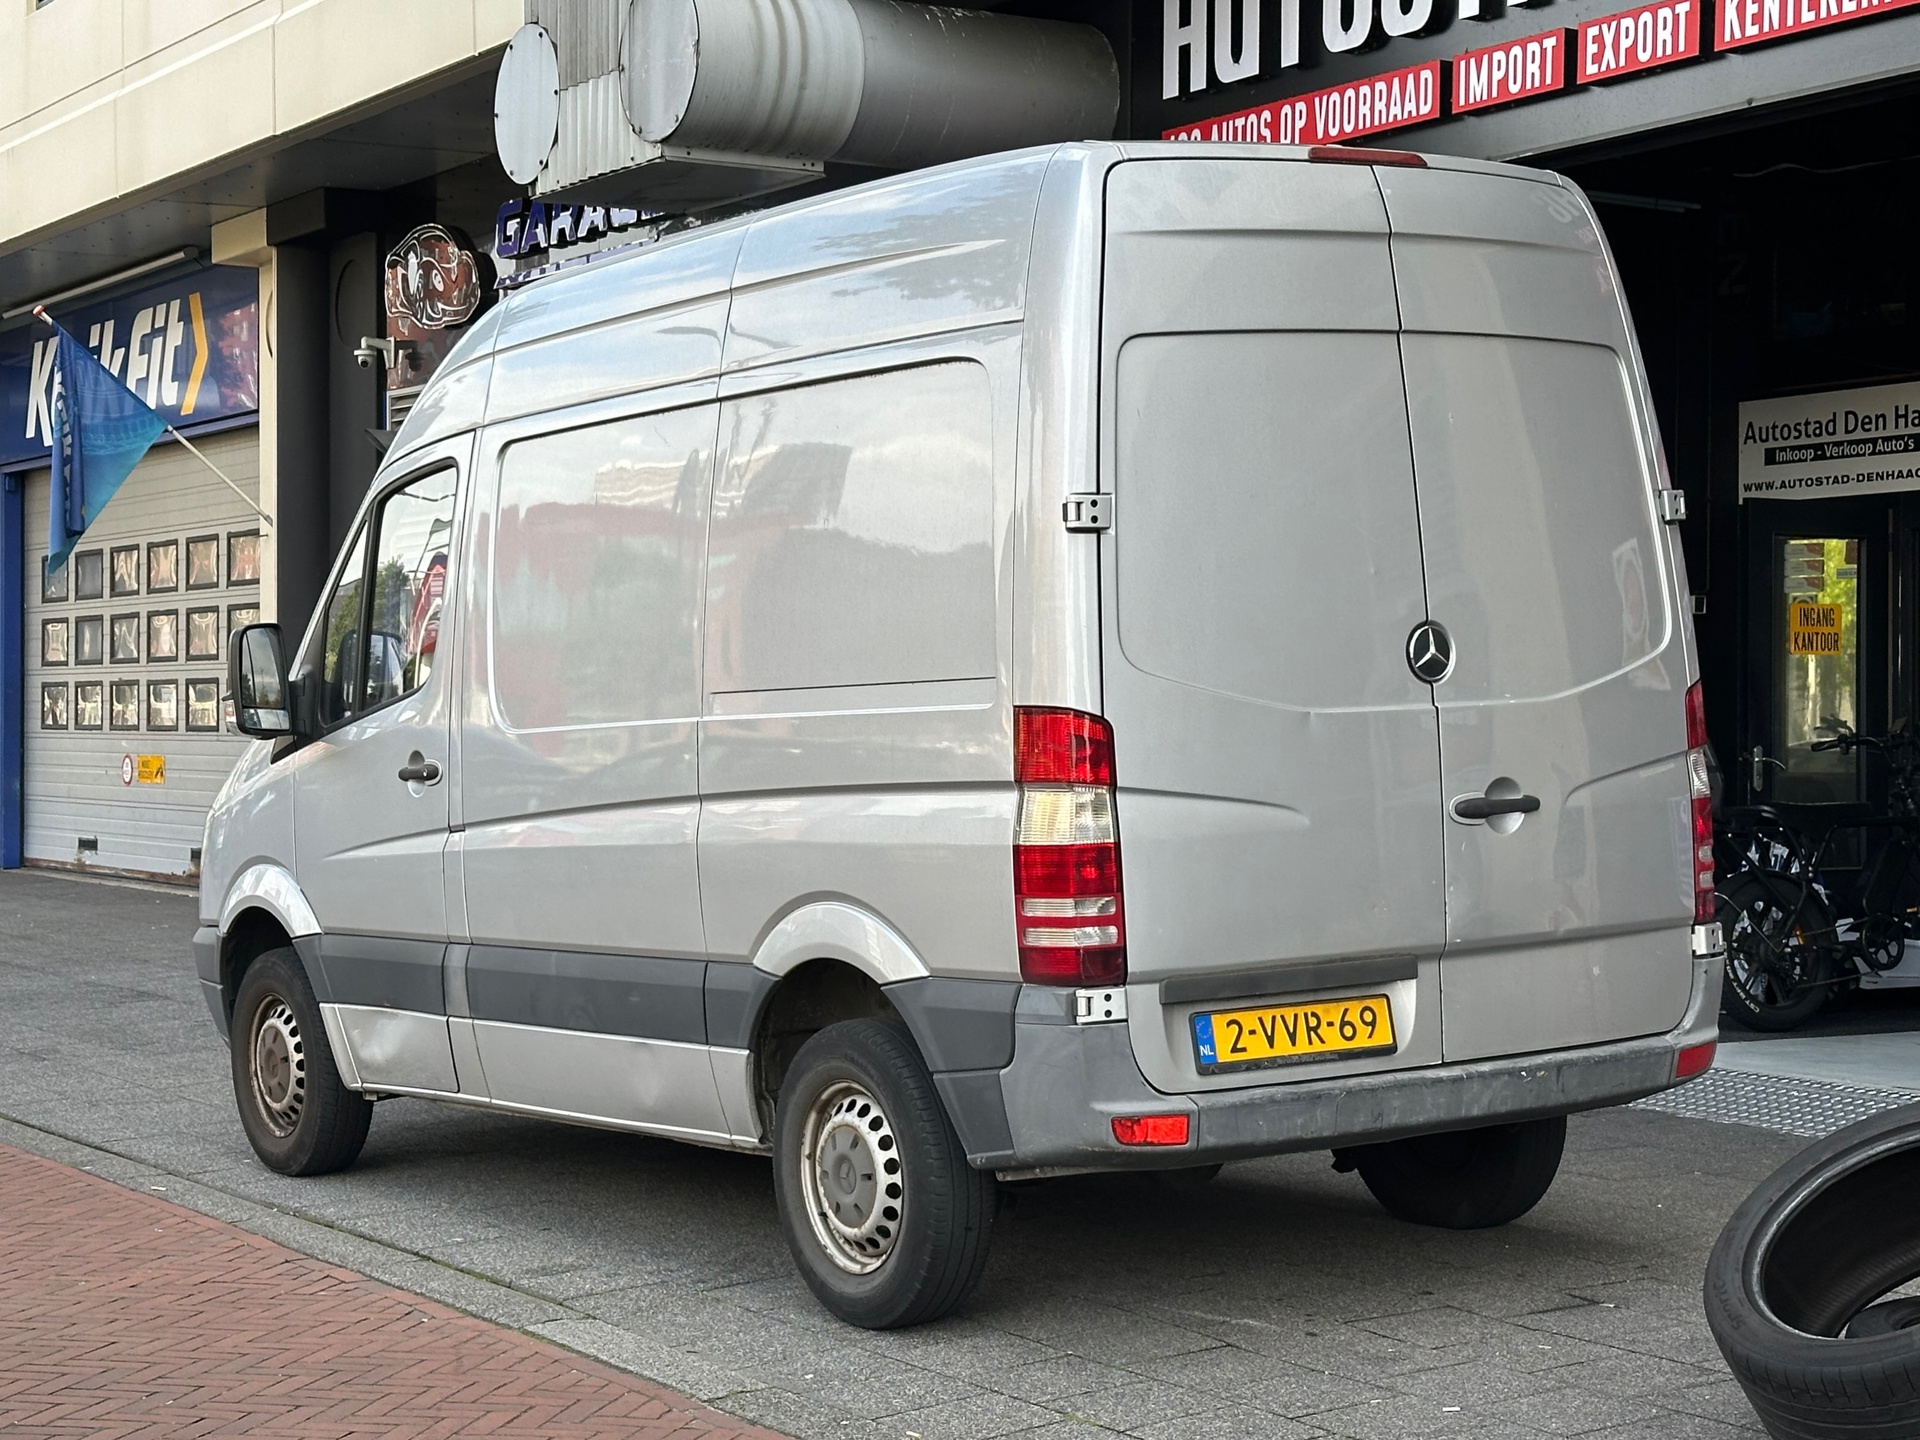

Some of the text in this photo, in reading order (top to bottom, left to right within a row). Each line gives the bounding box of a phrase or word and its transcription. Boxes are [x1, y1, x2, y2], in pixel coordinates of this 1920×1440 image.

[1585, 3, 1691, 76] EXPORT
[1458, 35, 1558, 107] IMPORT
[1280, 101, 1307, 144] OP
[1314, 69, 1433, 140] VOORRAAD
[496, 197, 666, 258] GARA
[1743, 411, 1837, 445] Autostad
[1844, 410, 1887, 434] Den
[1776, 447, 1814, 463] Inkoop
[1824, 441, 1873, 457] Verkoop
[1875, 436, 1915, 453] Auto's
[1799, 607, 1835, 628] INGANG
[1793, 631, 1840, 652] KANTOOR
[1200, 1044, 1215, 1056] NL
[1225, 1004, 1378, 1055] 2-VVR-69
